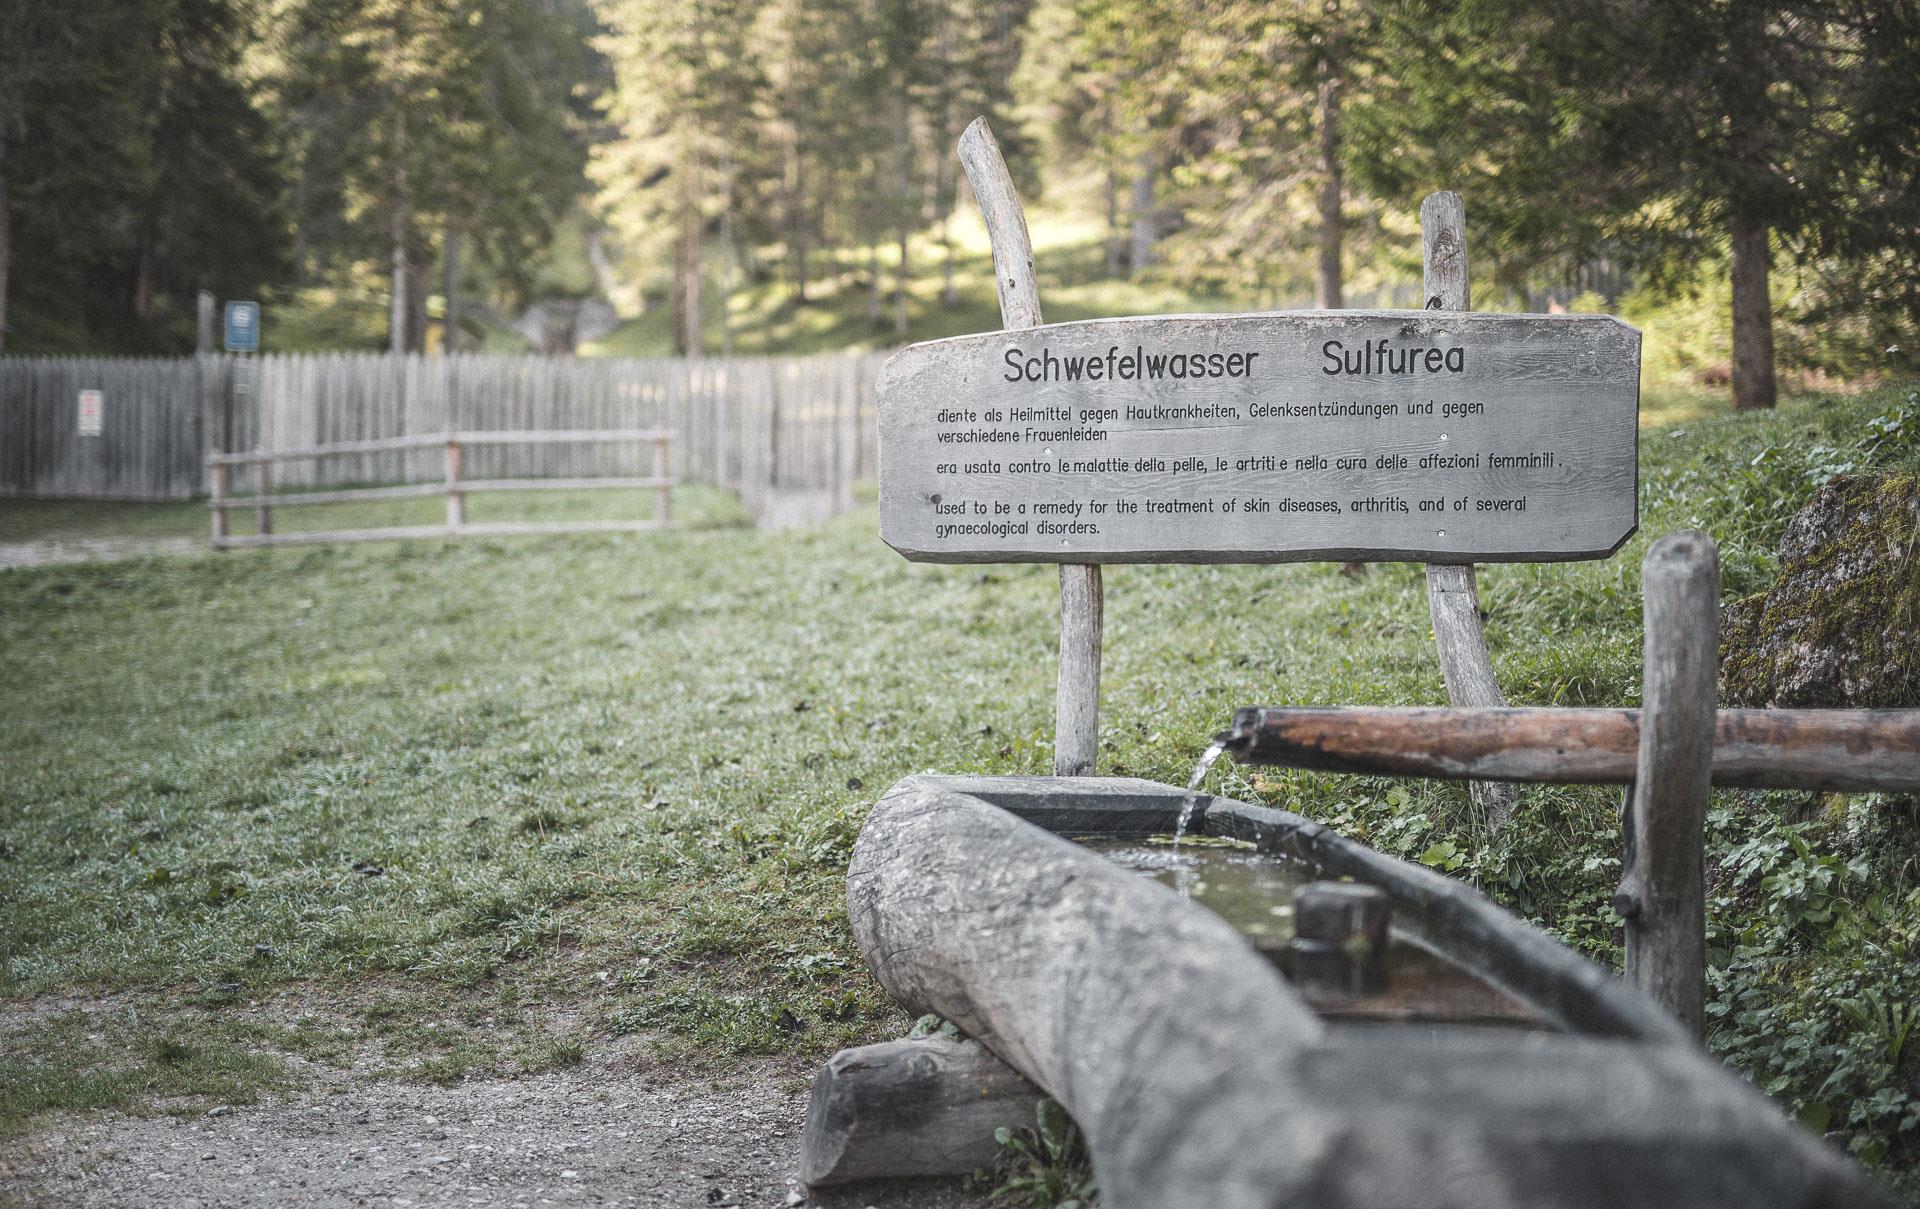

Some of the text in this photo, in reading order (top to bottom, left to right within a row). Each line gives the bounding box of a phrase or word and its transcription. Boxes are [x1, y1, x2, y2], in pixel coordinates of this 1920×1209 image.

[1004, 339, 1465, 383] Schwefelwasser Sulfurea
[937, 400, 1484, 424] diente als Heilmittel gegen Hautkrankheiten, Gelenksentzündungen und gegen
[937, 427, 1108, 444] verschiedene Frauenleiden
[936, 462, 957, 474] era
[964, 460, 1001, 474] usata
[1008, 460, 1051, 474] contro
[1058, 458, 1070, 473] le
[1073, 458, 1129, 473] malattie
[1134, 458, 1165, 473] della
[1173, 457, 1208, 475] pelle,
[1216, 457, 1228, 472] le
[1236, 455, 1275, 471] artriti
[1279, 457, 1288, 469] e
[1295, 455, 1328, 470] nella
[1335, 456, 1367, 469] cura
[1375, 454, 1408, 469] delle
[1419, 453, 1480, 469] affezioni
[935, 496, 1527, 518] used to be a remedy for the treatment of skin diseases, arthritis, and of several
[935, 520, 1100, 539] gynaecological disorders.
